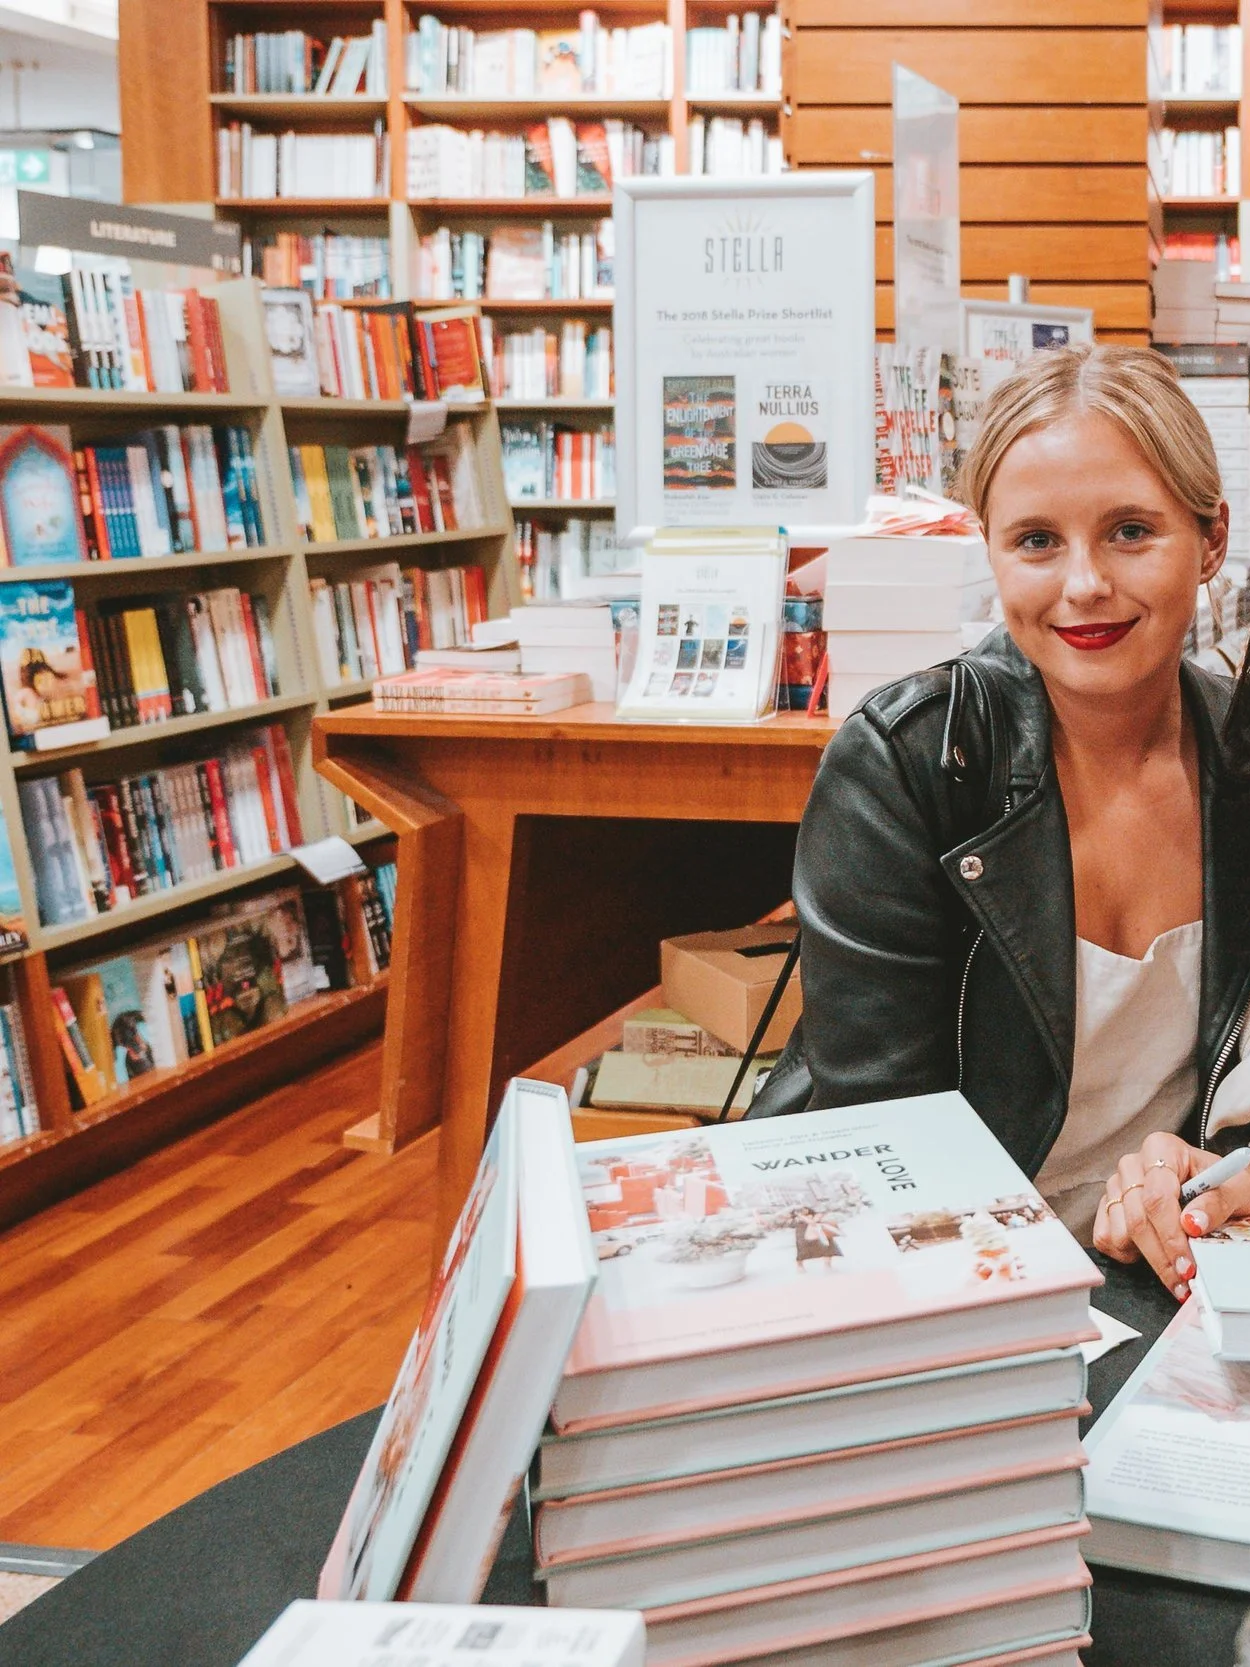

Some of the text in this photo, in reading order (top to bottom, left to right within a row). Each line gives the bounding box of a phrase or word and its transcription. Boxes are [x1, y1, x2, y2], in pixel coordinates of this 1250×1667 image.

[90, 219, 177, 247] LITERATURE
[705, 236, 783, 273] STELLA
[657, 308, 833, 323] The 2018 Stella Prize Shortlist
[765, 385, 812, 399] TERRA
[666, 405, 736, 423] ENLIGHTENMENT
[759, 401, 819, 416] NULLIUS
[671, 442, 729, 460] GREENGAGE
[687, 461, 712, 473] TREE
[880, 448, 897, 494] KRETSE
[752, 1144, 895, 1171] WANDER
[877, 1157, 917, 1191] LOVE
